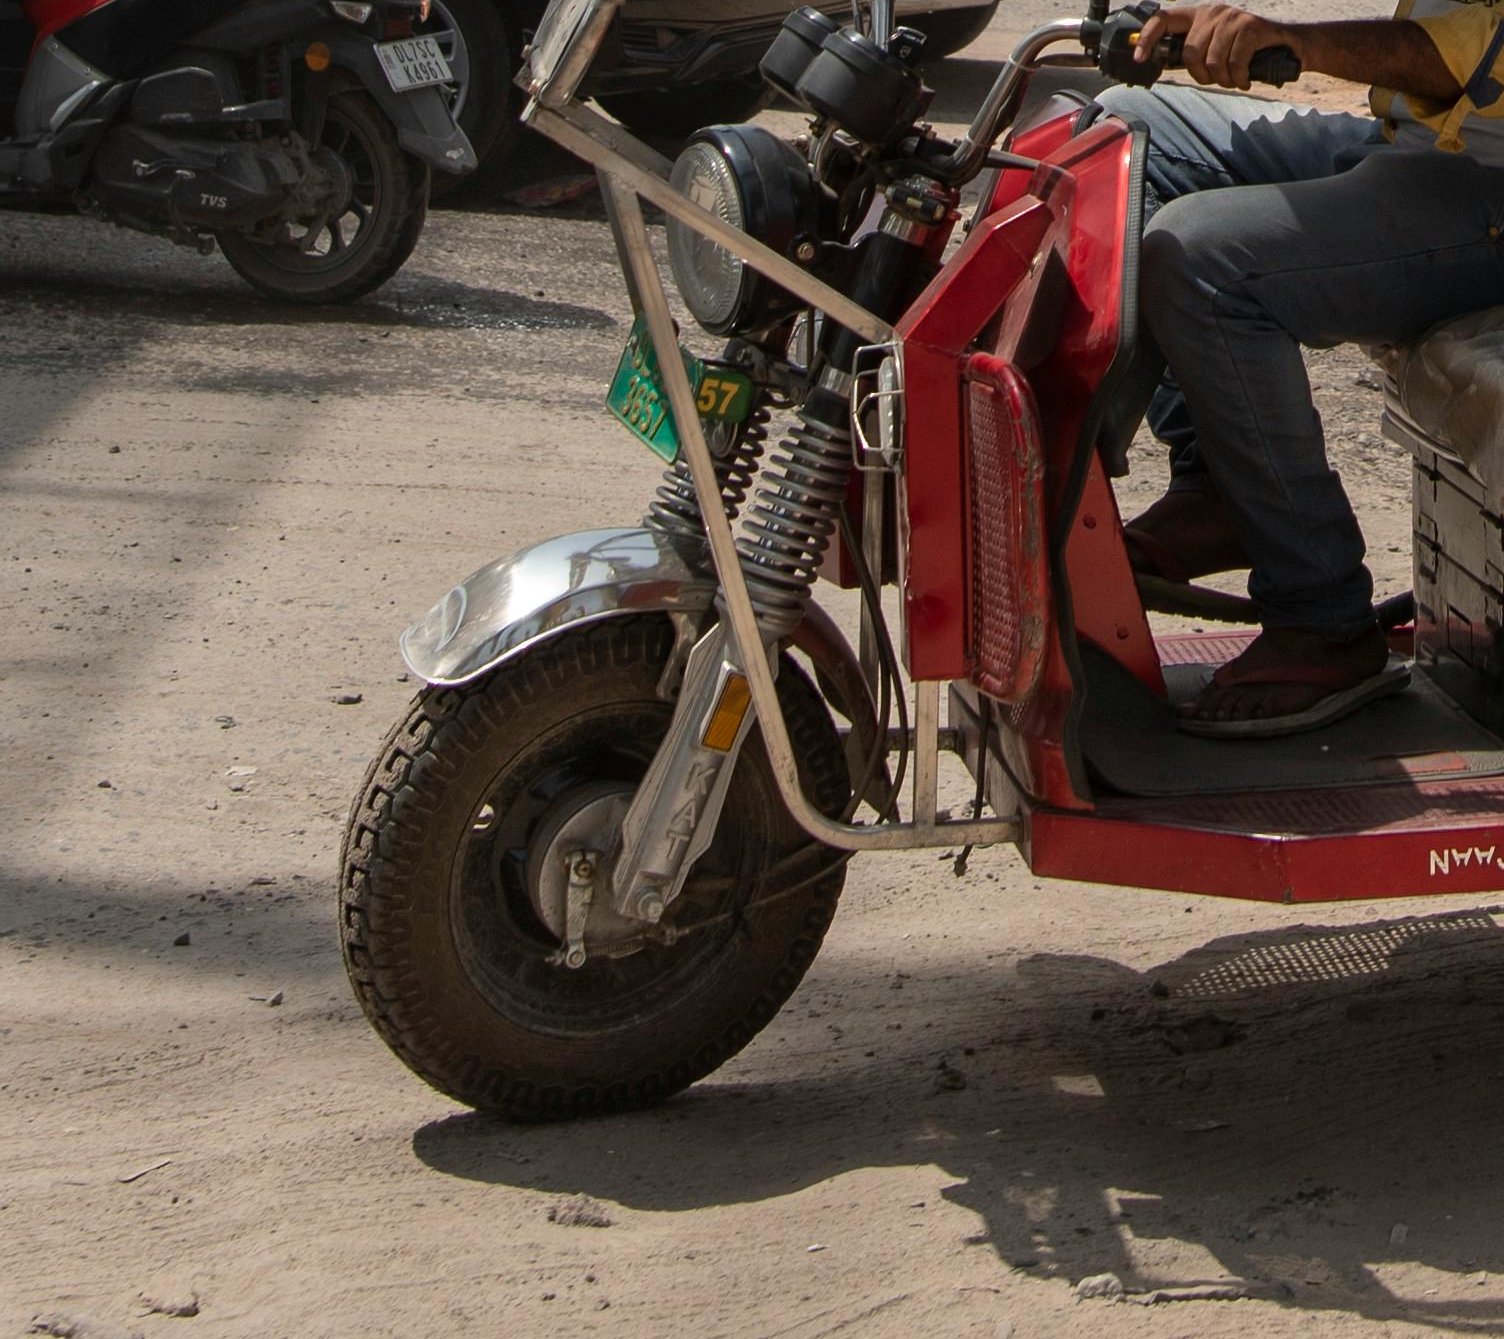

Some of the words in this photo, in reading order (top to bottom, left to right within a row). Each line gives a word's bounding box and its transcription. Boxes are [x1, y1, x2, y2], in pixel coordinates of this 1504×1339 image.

[392, 36, 436, 63] DL7SC
[200, 192, 228, 209] TVS
[698, 379, 739, 416] 57
